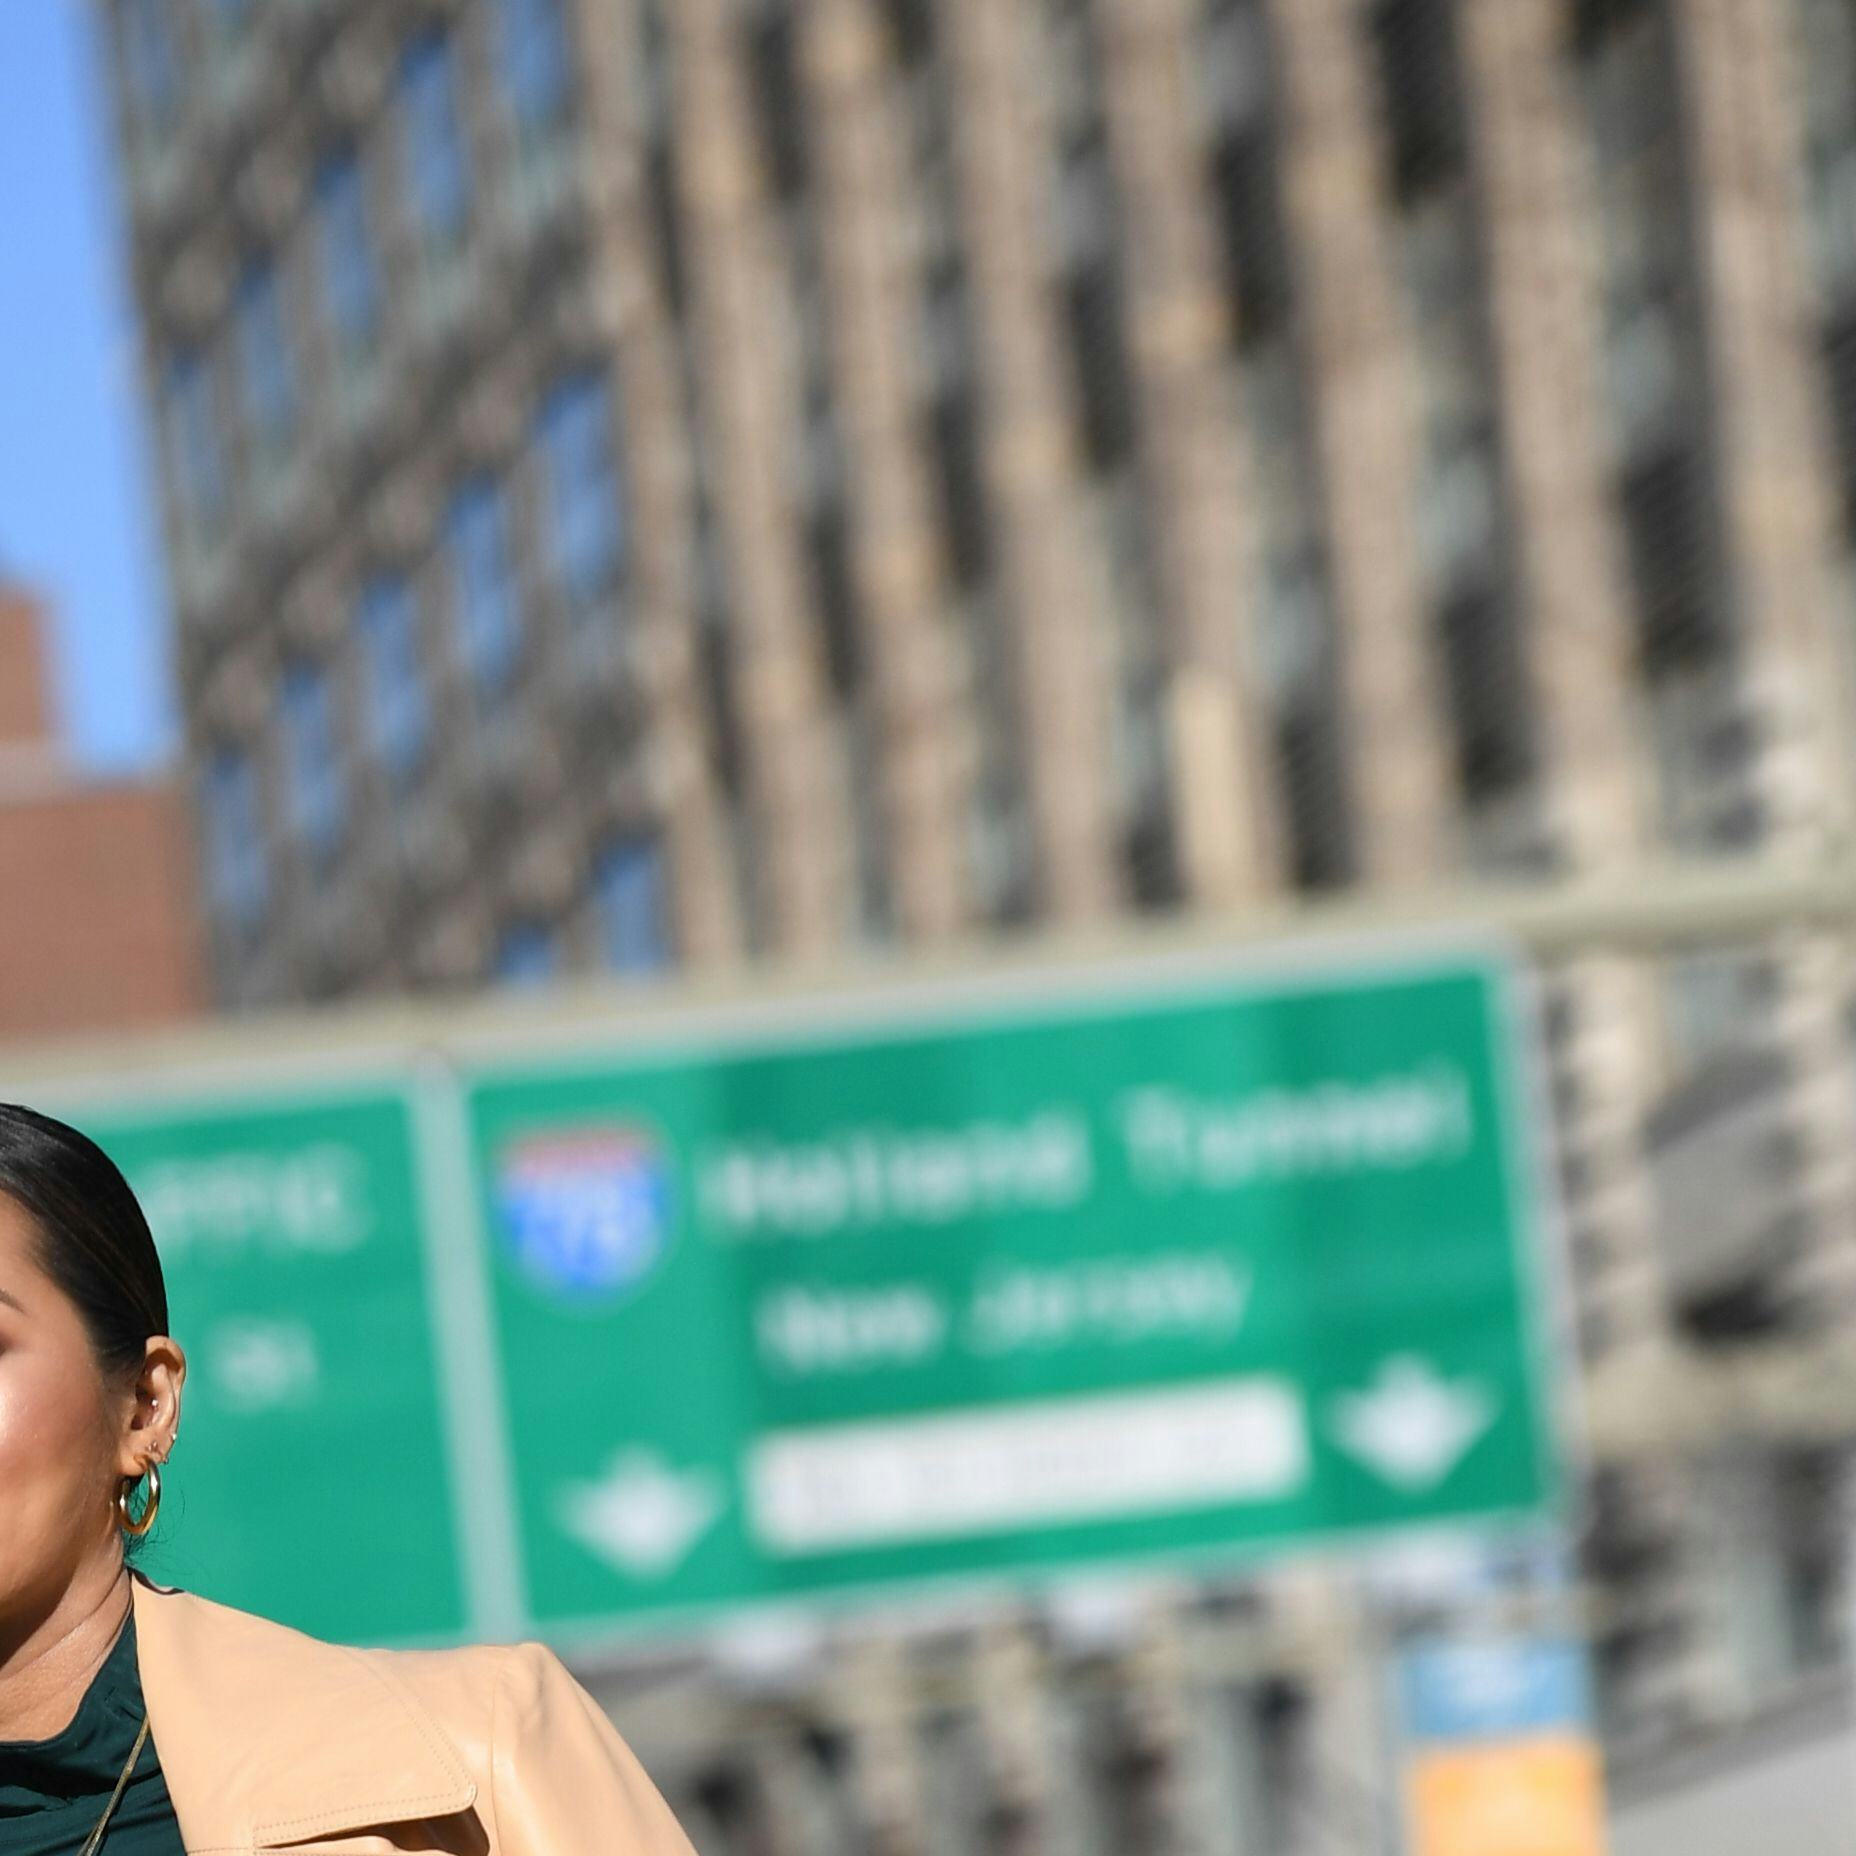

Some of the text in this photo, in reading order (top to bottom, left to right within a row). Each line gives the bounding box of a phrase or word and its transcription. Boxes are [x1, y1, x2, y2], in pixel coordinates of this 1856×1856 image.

[692, 1064, 1474, 1236] Holland Tunnel
[754, 1248, 1253, 1373] New Jersey
